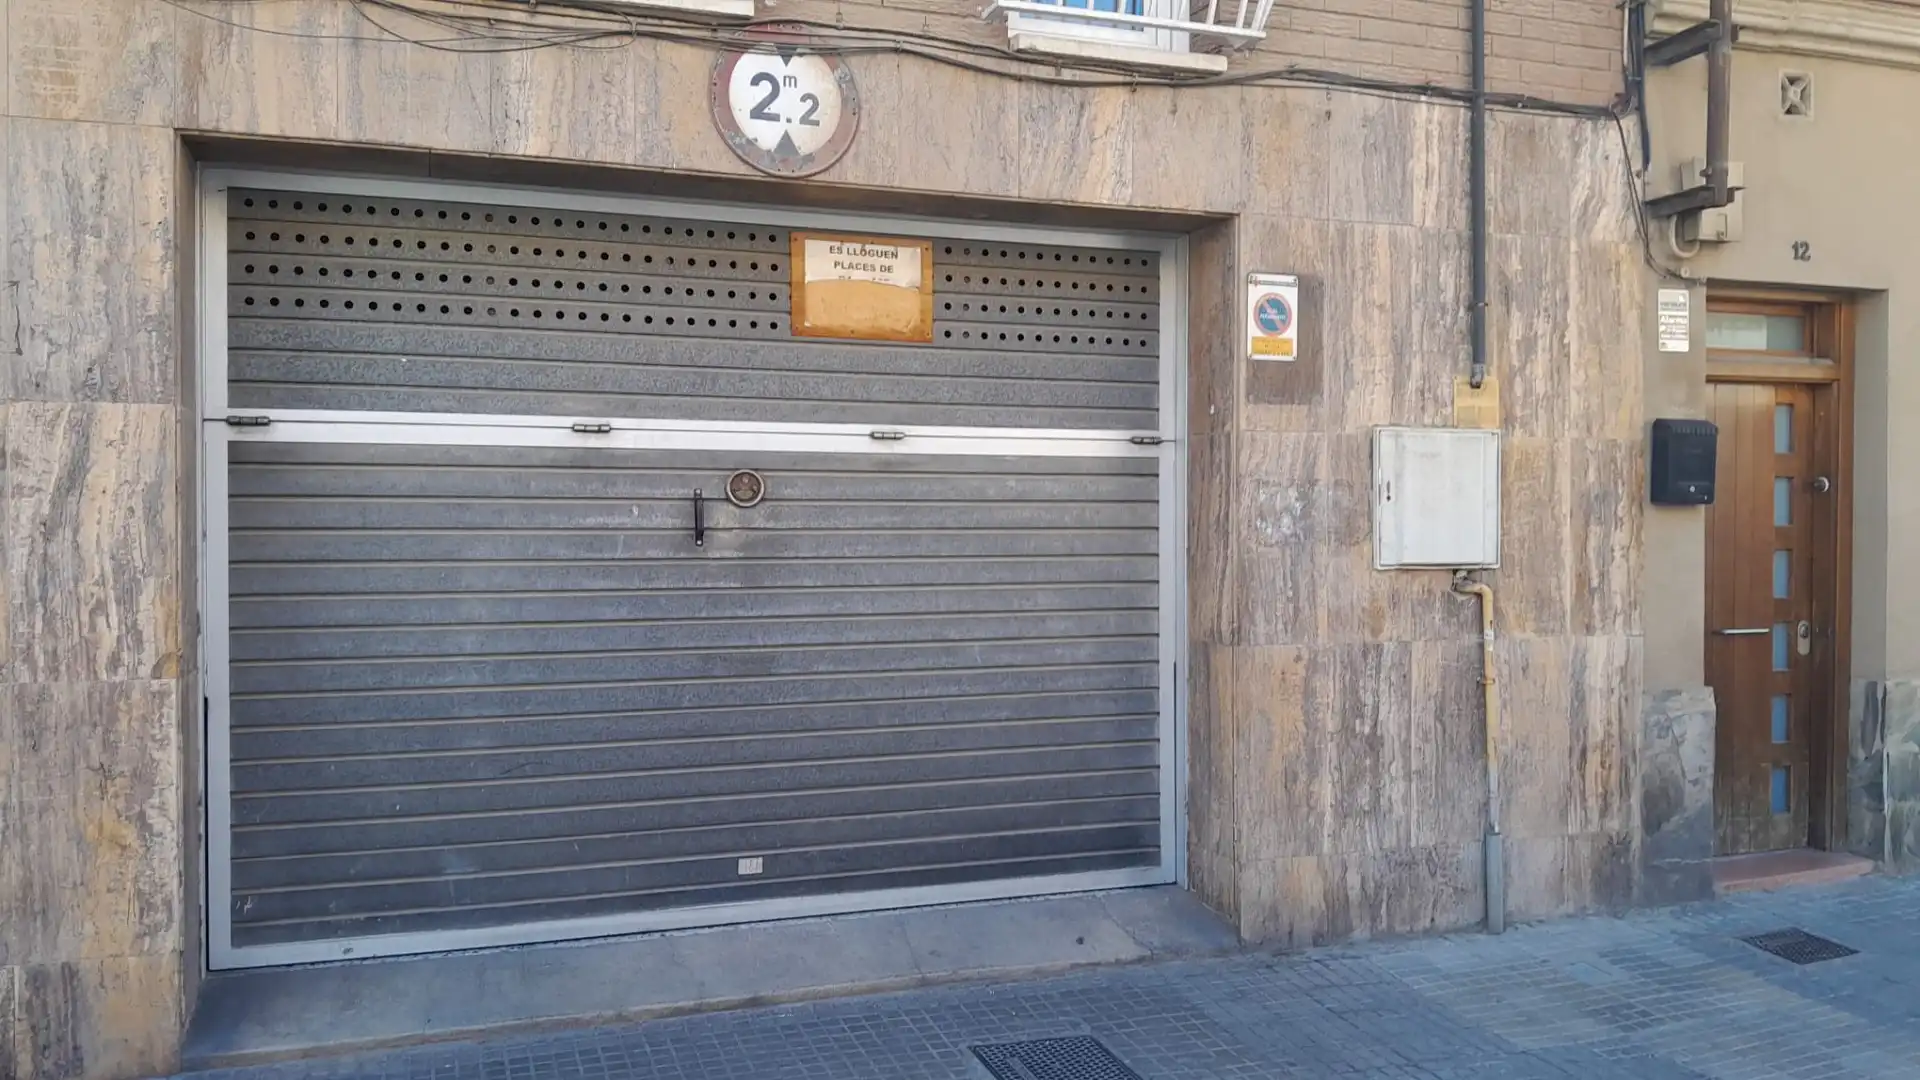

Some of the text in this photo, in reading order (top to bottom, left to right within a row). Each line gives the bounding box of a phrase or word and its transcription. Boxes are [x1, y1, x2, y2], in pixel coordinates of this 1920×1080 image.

[829, 245, 899, 260] ES LLOGUEN
[1791, 240, 1811, 262] 12
[833, 260, 894, 274] PLACES DE
